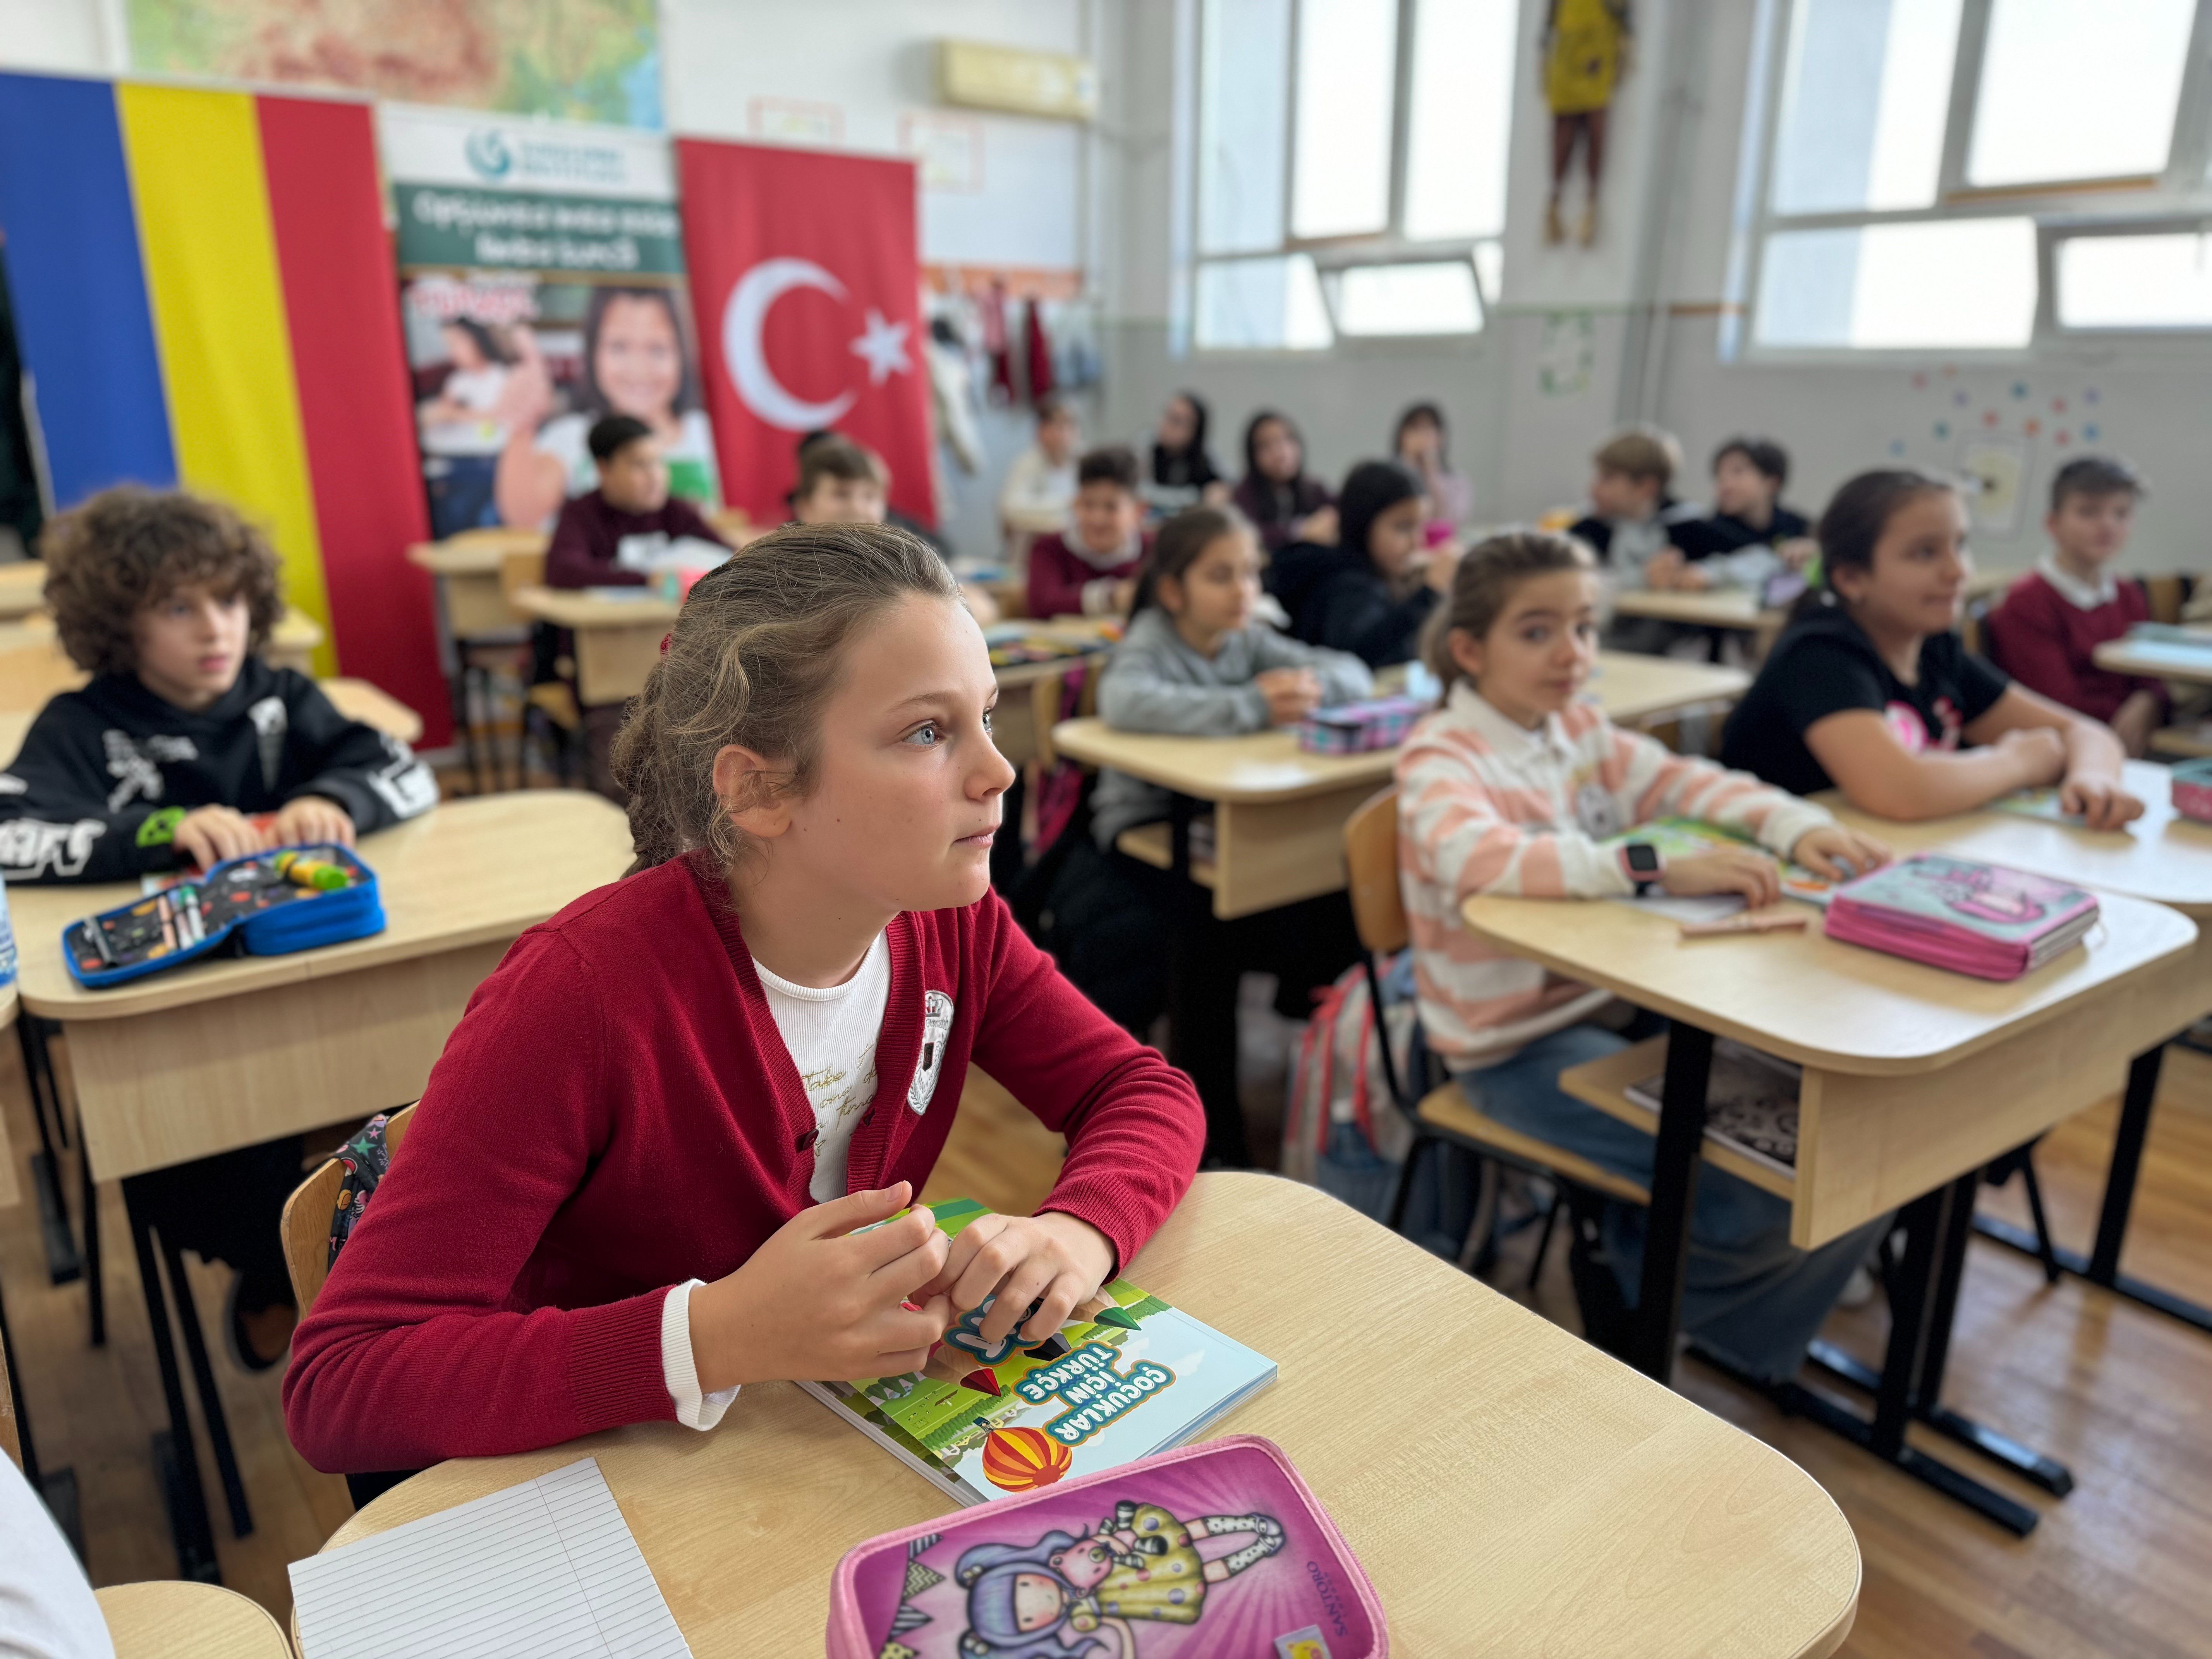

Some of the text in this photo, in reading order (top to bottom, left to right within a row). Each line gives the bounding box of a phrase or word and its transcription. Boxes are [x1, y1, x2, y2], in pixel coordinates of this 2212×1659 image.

[1022, 1347, 1113, 1400] TÜRKÇE
[1054, 1366, 1167, 1441] ÇOCUKLAR
[1066, 1371, 1121, 1403] İÇİN
[1307, 1561, 1349, 1637] SANTORO
